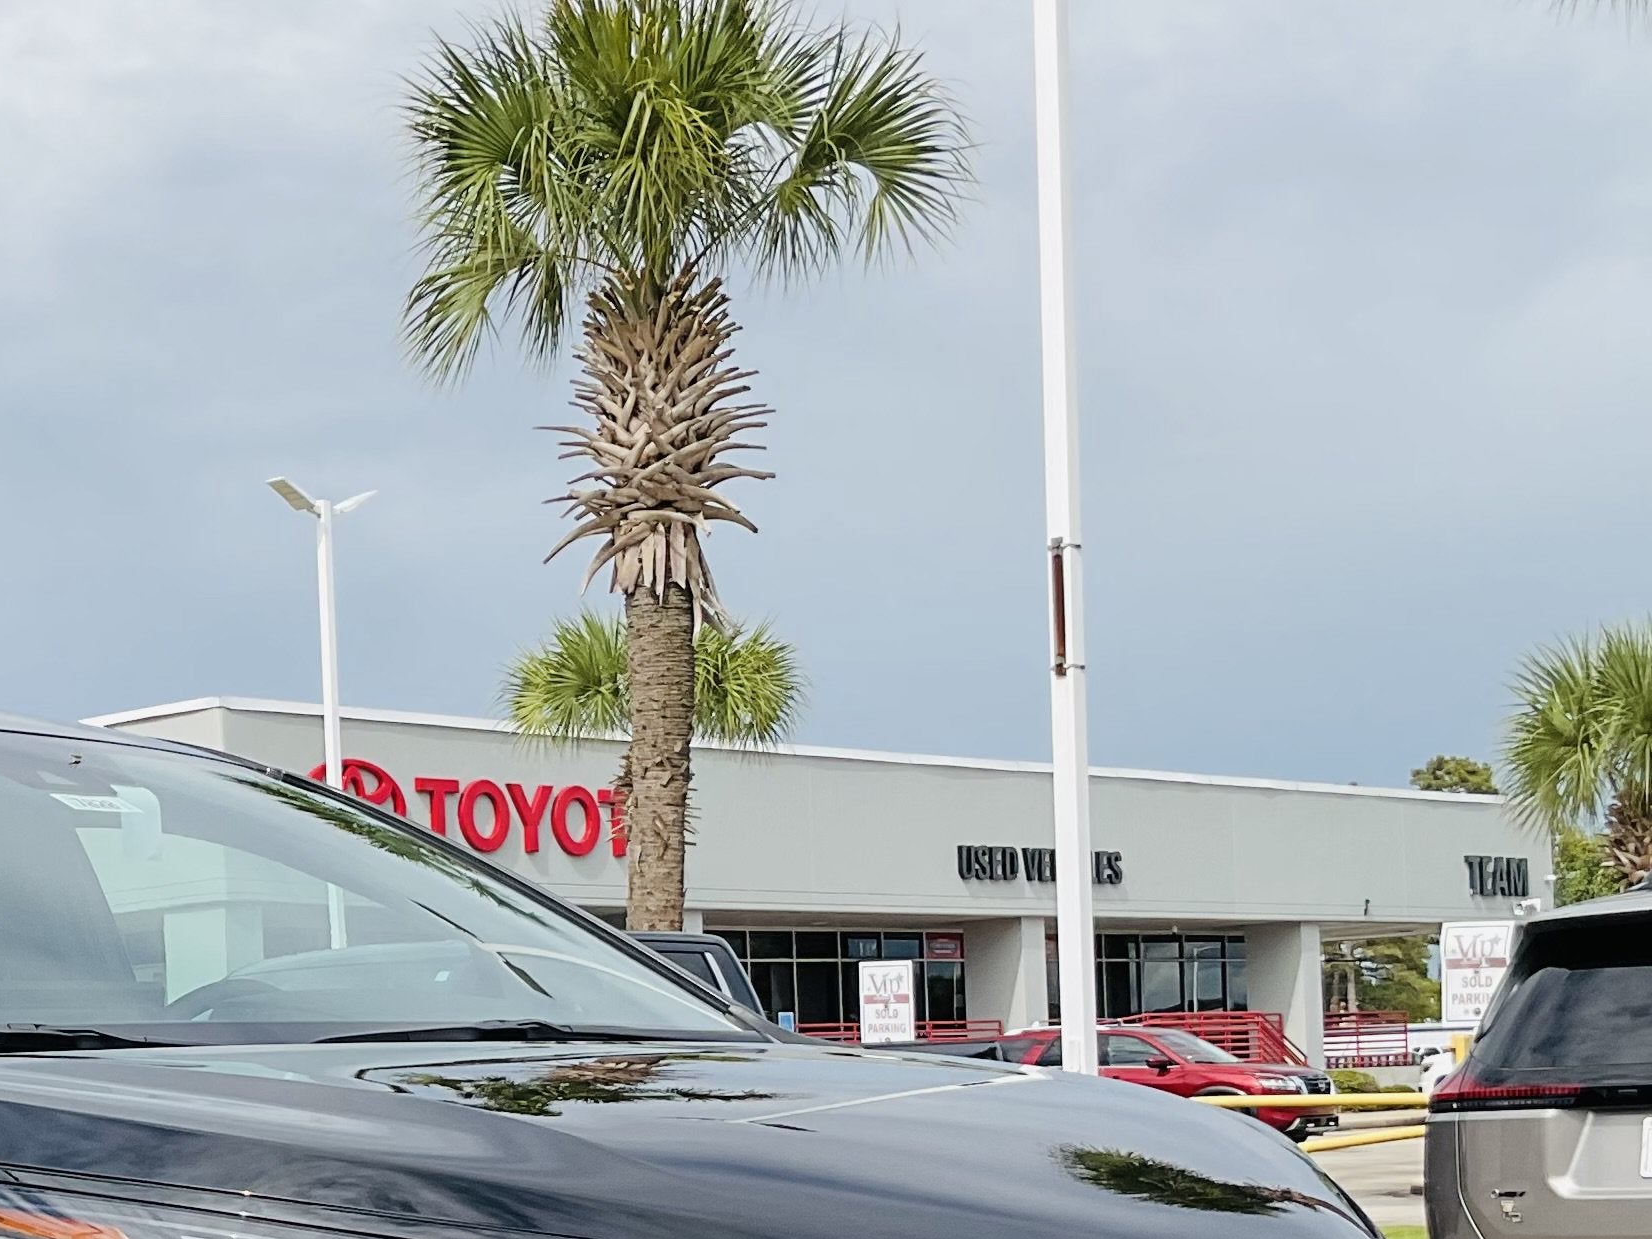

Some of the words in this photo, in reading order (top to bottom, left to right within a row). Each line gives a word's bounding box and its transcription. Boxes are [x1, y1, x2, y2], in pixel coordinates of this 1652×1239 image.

[414, 776, 628, 858] TOYOT
[956, 845, 1019, 880] USED
[1021, 847, 1123, 884] VEES
[1463, 855, 1529, 896] TEAM
[1461, 976, 1493, 989] SOLD
[1451, 992, 1490, 1005] PARKI
[875, 1009, 898, 1019] SOLD
[867, 1023, 906, 1033] PARKING
